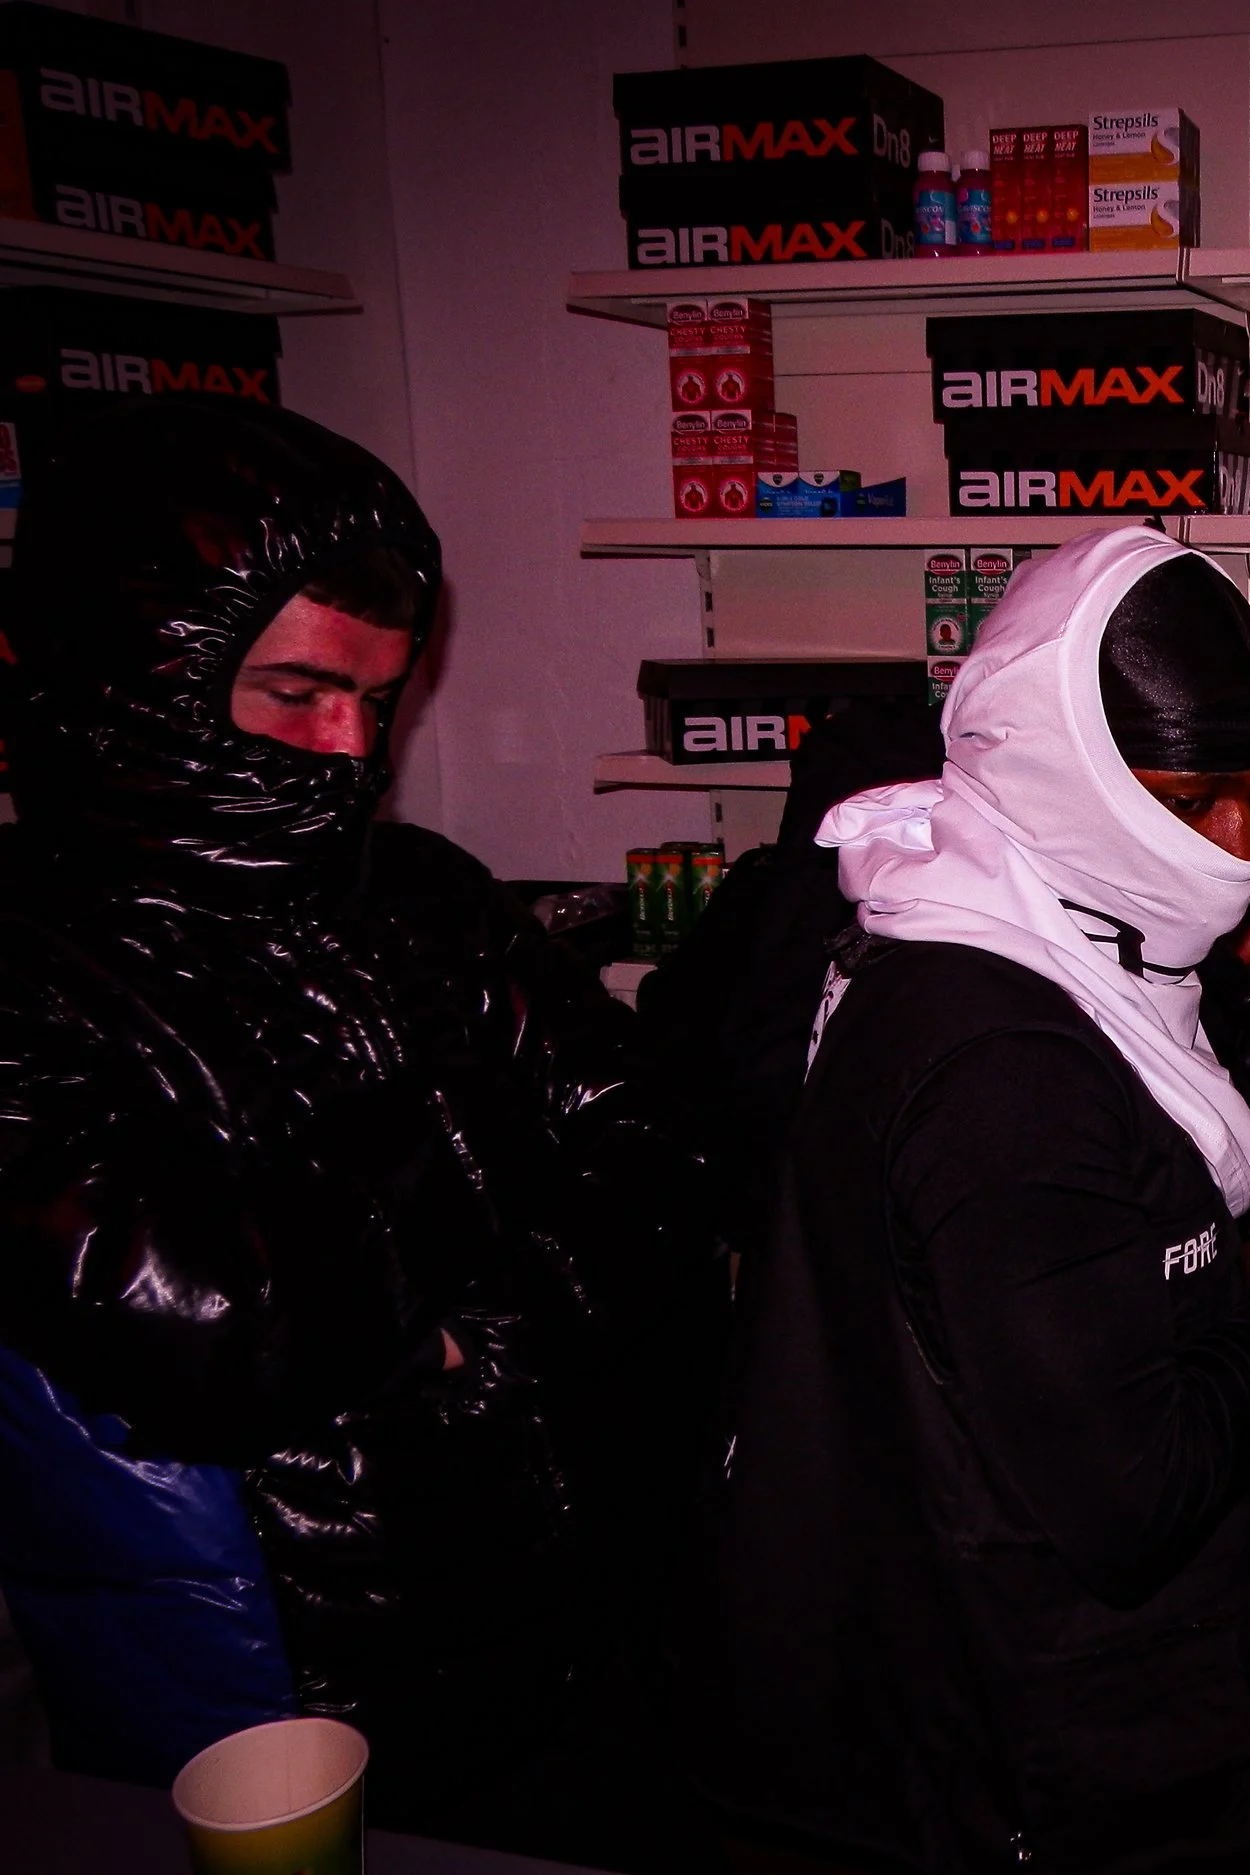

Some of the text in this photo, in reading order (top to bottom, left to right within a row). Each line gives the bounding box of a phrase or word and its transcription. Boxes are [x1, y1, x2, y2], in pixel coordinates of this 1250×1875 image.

[1093, 113, 1158, 132] Strepsils
[992, 134, 1017, 144] DEEP
[1023, 132, 1048, 142] DEEP
[1054, 130, 1079, 140] DEEP
[873, 113, 911, 169] Dn8
[993, 143, 1015, 155] HEAT
[1023, 143, 1046, 153] HEAT
[1054, 141, 1077, 152] HEAT
[1093, 186, 1158, 204] Strepsils
[673, 310, 702, 320] Benylin
[713, 309, 743, 319] Benylin
[670, 328, 705, 336] CHESTY
[710, 325, 746, 334] CHESTY
[1198, 359, 1225, 409] Dn8
[676, 420, 705, 430] Benylin
[717, 419, 746, 429] Benylin
[673, 437, 709, 445] CHESTY
[713, 436, 749, 444] CHESTY
[930, 559, 960, 569] Benylin
[977, 559, 1007, 569] Benylin
[929, 576, 960, 584] Infant's
[975, 576, 1008, 584] Infant's
[978, 585, 1005, 593] Cough
